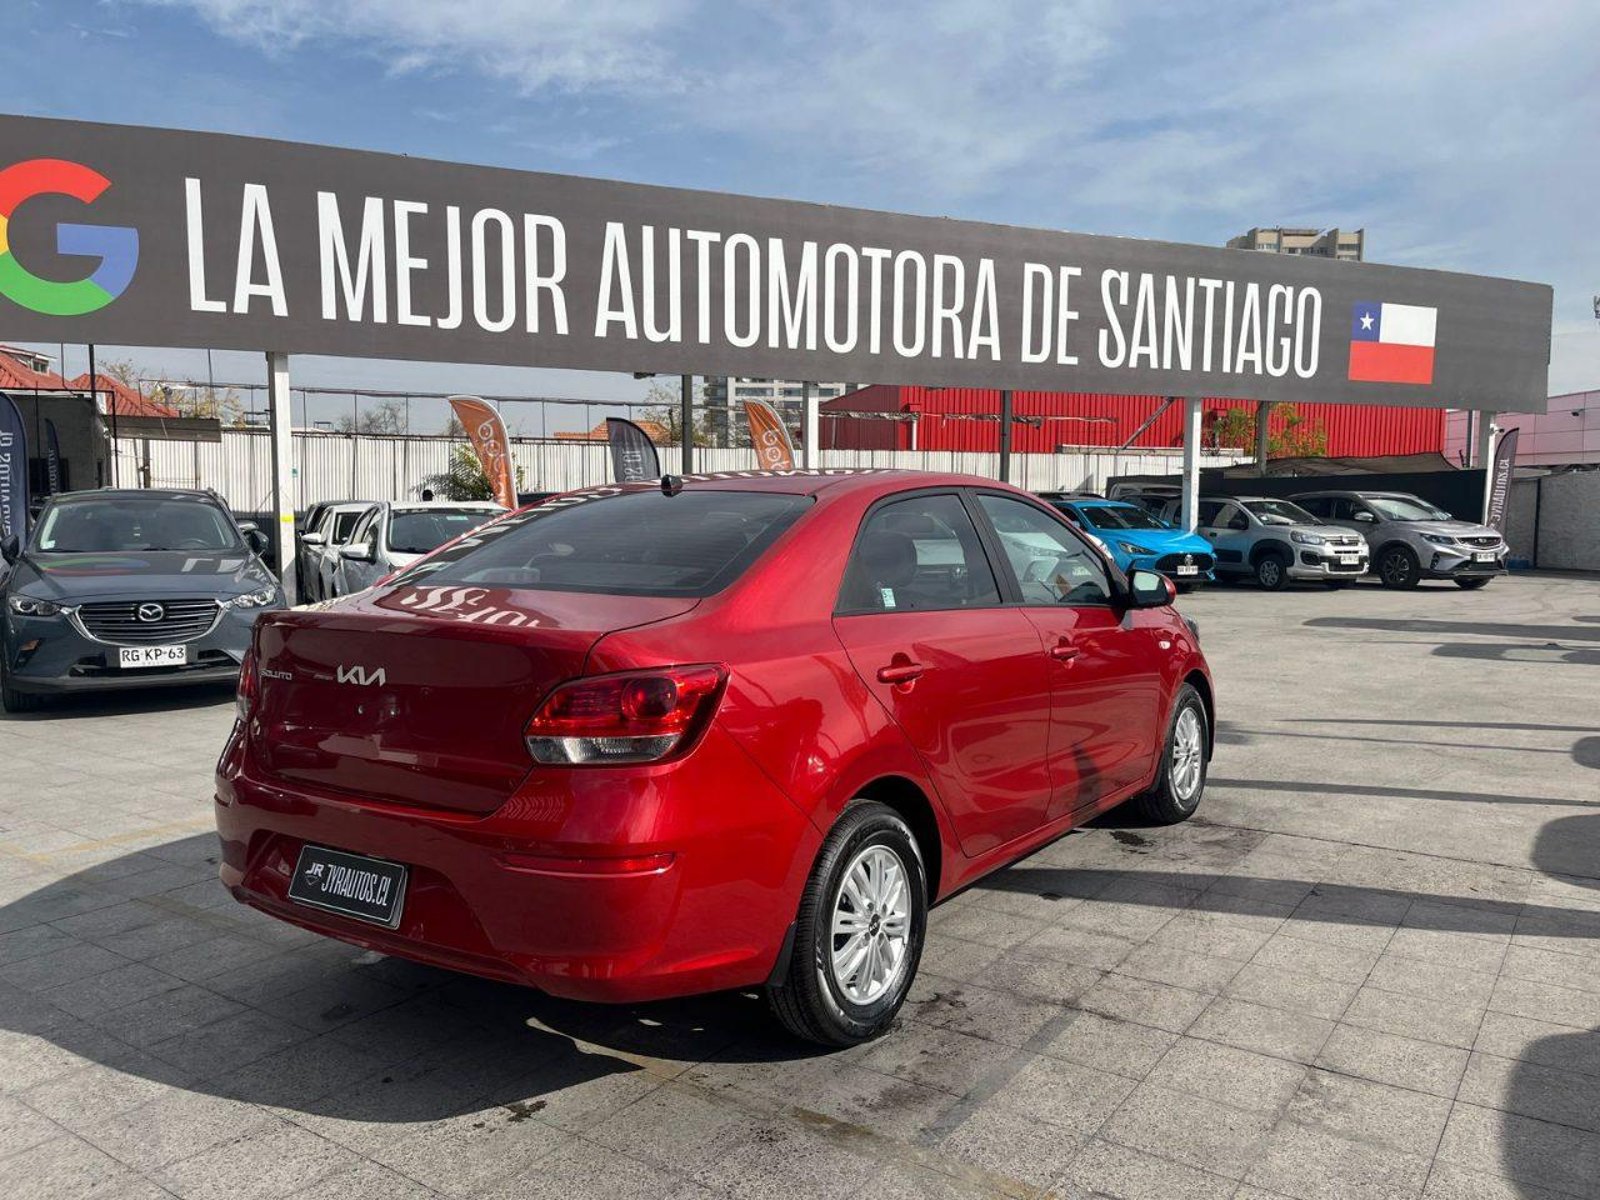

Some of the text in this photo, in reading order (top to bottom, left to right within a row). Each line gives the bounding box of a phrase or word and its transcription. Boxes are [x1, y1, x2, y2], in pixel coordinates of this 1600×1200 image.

[185, 177, 1322, 379] LA MEJOR AUTOMOTORA DE SANTIAGO
[122, 650, 139, 661] RG
[337, 665, 386, 687] KIA
[305, 863, 325, 877] JR
[321, 864, 391, 906] JYRAUTOS.CL
